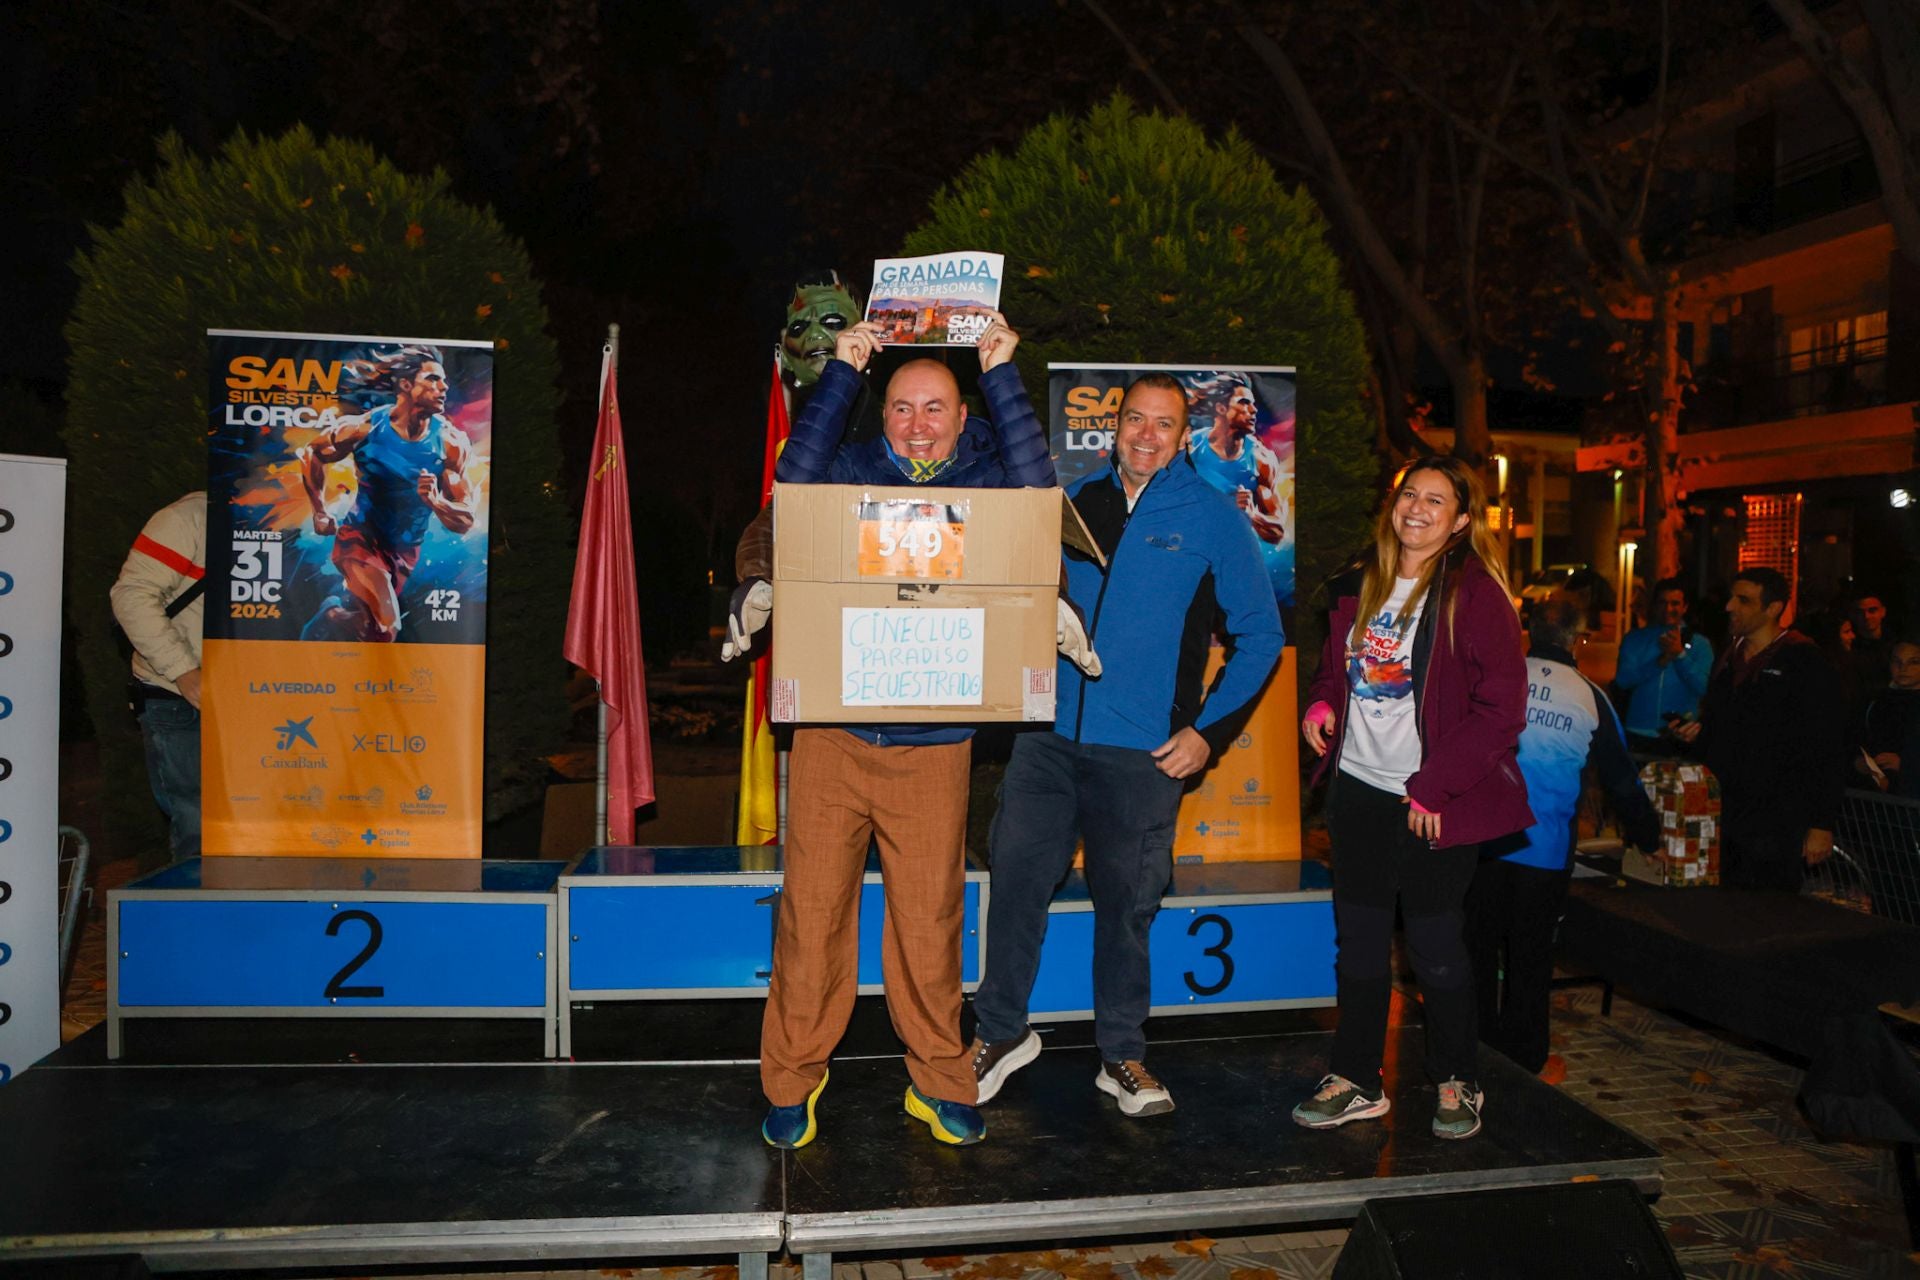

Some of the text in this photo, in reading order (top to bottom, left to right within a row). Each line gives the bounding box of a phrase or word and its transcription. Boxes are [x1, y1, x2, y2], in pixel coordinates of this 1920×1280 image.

[880, 259, 991, 283] GRANADA
[876, 281, 985, 296] PARA 2 PERSONAS
[946, 334, 981, 345] LORC
[225, 356, 342, 393] SAN
[228, 390, 339, 405] SILVESTRE
[1064, 386, 1124, 417] SA
[225, 404, 339, 428] LORCA
[233, 530, 282, 541] MARTES
[878, 526, 943, 558] 549
[231, 542, 283, 581] 31
[231, 580, 282, 602] DIC
[231, 604, 280, 619] 2024
[432, 609, 457, 621] KM
[250, 682, 336, 695] LA VERDAD
[354, 678, 415, 695] dpts
[1528, 683, 1552, 703] A.D.
[352, 734, 426, 753] X-ELIO
[261, 754, 329, 769] CaixaBank
[323, 908, 385, 999] 2
[1183, 913, 1235, 997] 3
